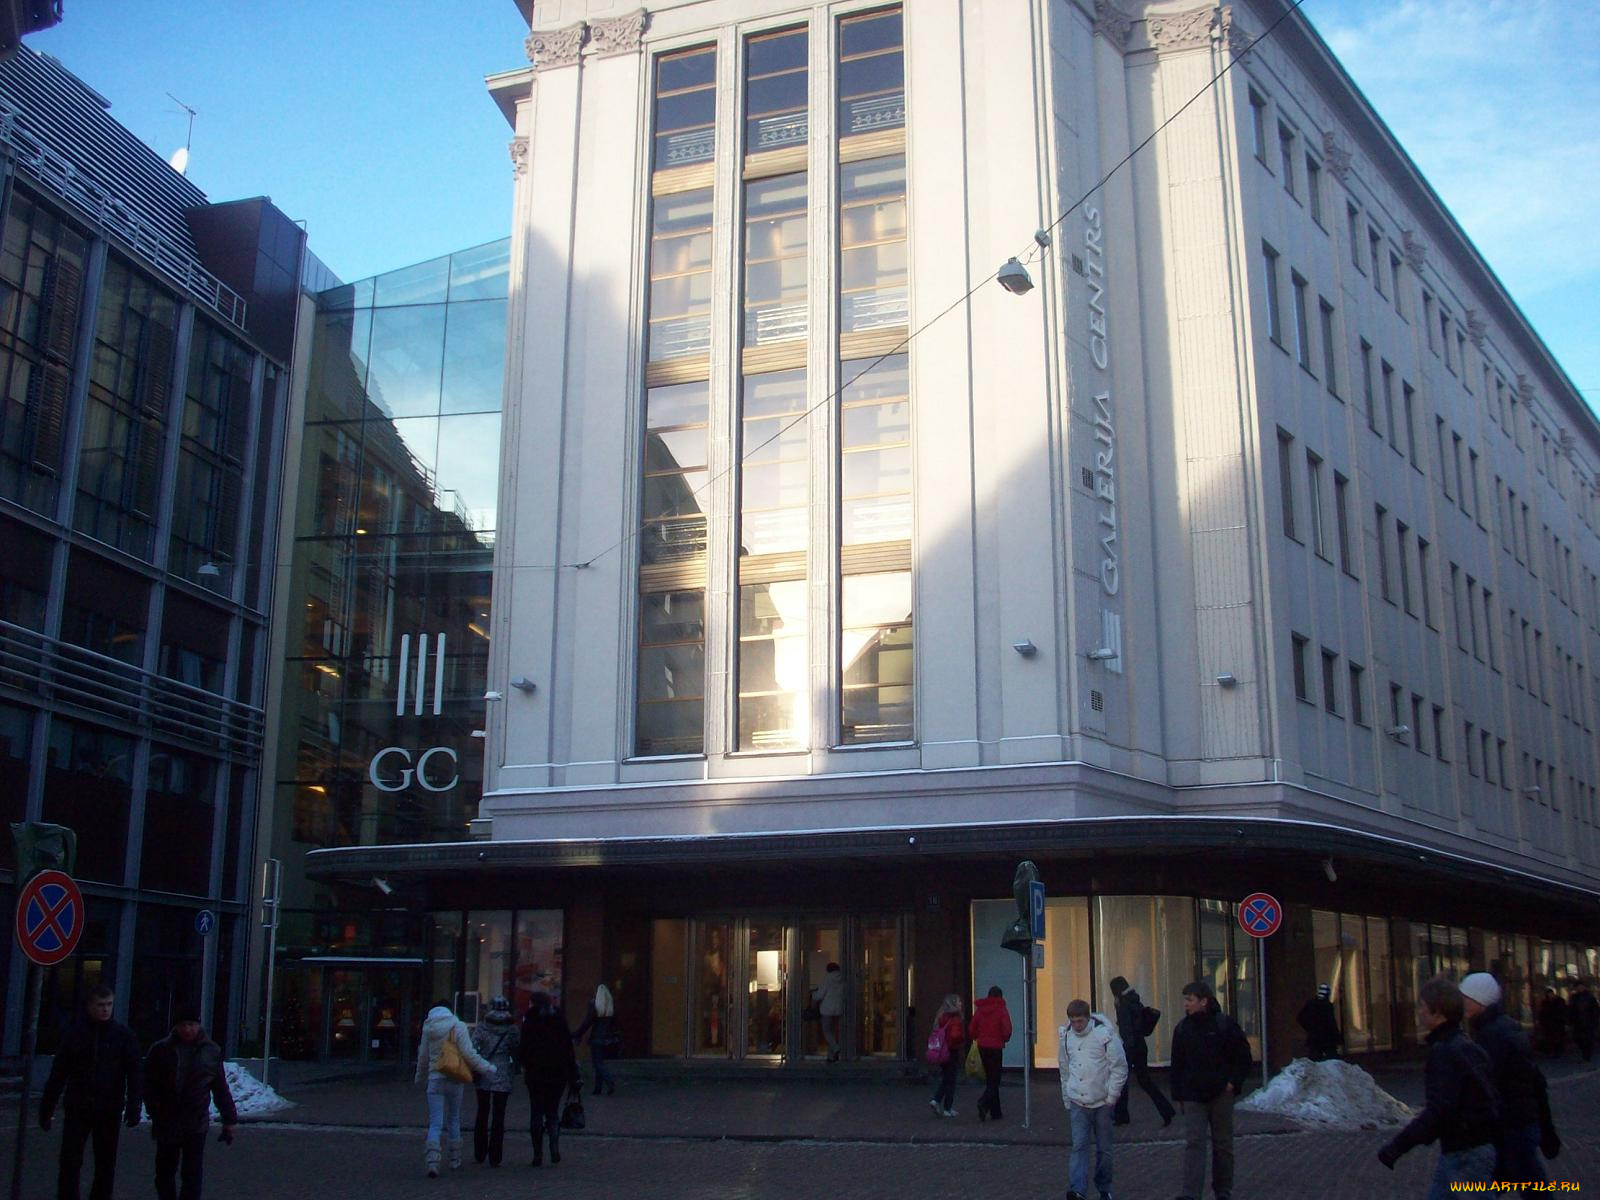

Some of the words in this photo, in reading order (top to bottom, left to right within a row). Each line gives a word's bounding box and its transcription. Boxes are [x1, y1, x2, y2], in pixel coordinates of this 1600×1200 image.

[1085, 202, 1107, 369] CENTRS
[1093, 391, 1118, 595] GALERIJA
[369, 747, 459, 792] GC
[1034, 888, 1043, 933] P
